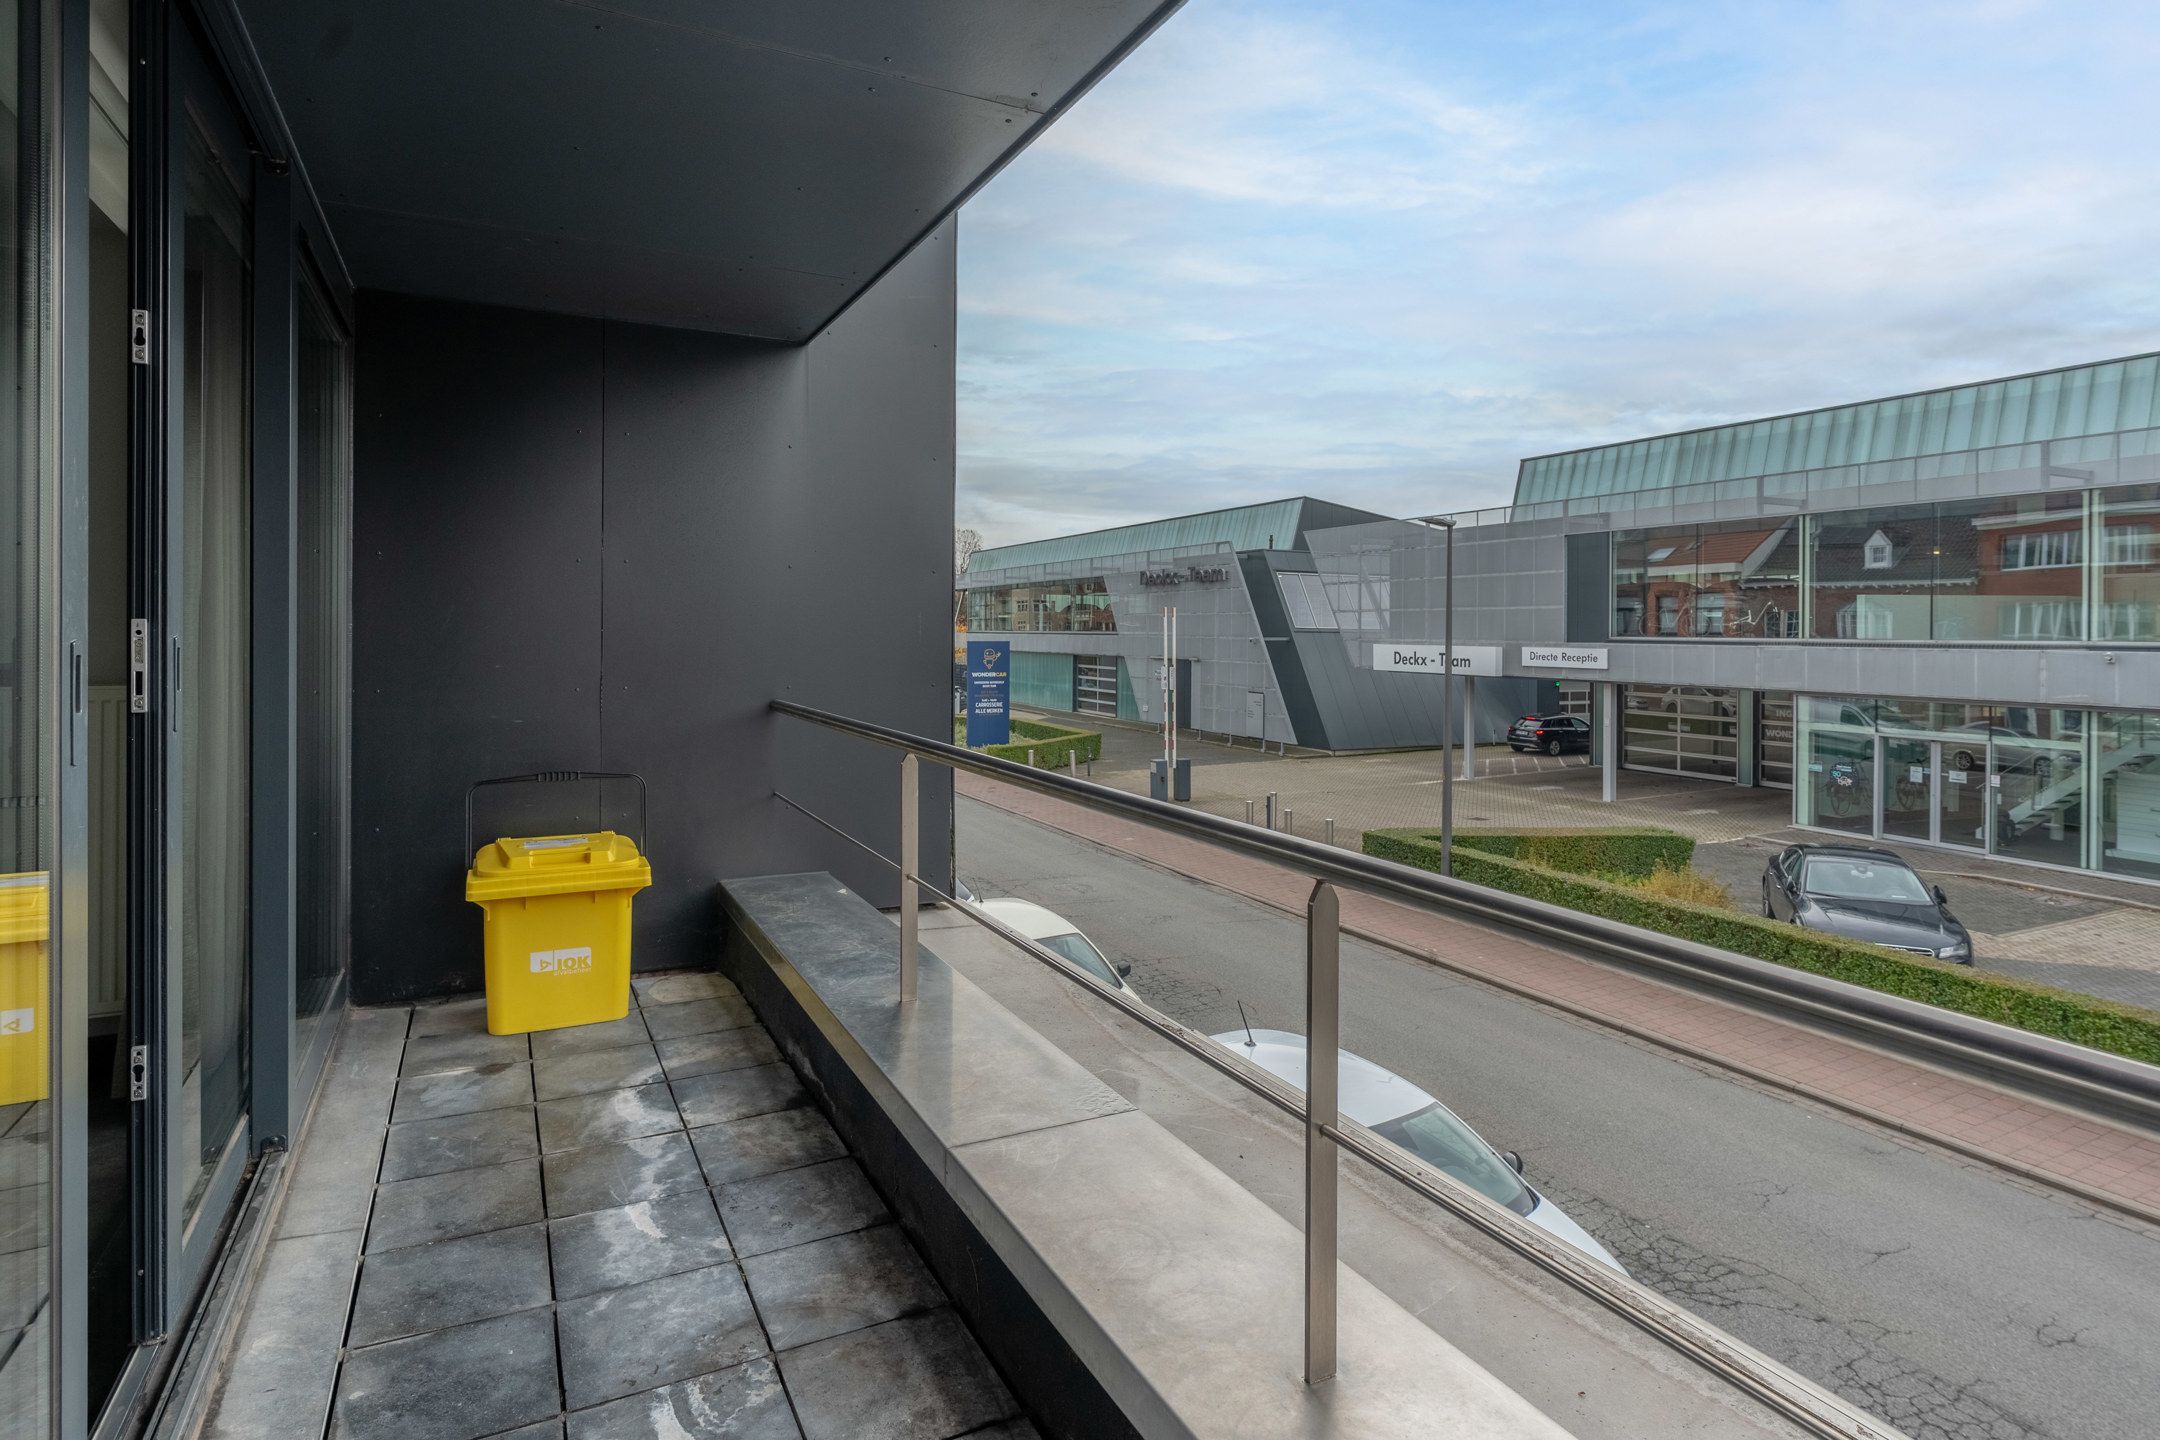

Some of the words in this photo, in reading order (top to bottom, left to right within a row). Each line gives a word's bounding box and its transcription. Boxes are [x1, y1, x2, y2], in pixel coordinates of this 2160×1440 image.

[1393, 651, 1428, 666] Deckx
[1438, 652, 1471, 668] Tam
[1529, 651, 1559, 662] Directe
[1561, 652, 1599, 664] Receptie
[557, 956, 591, 970] IOK
